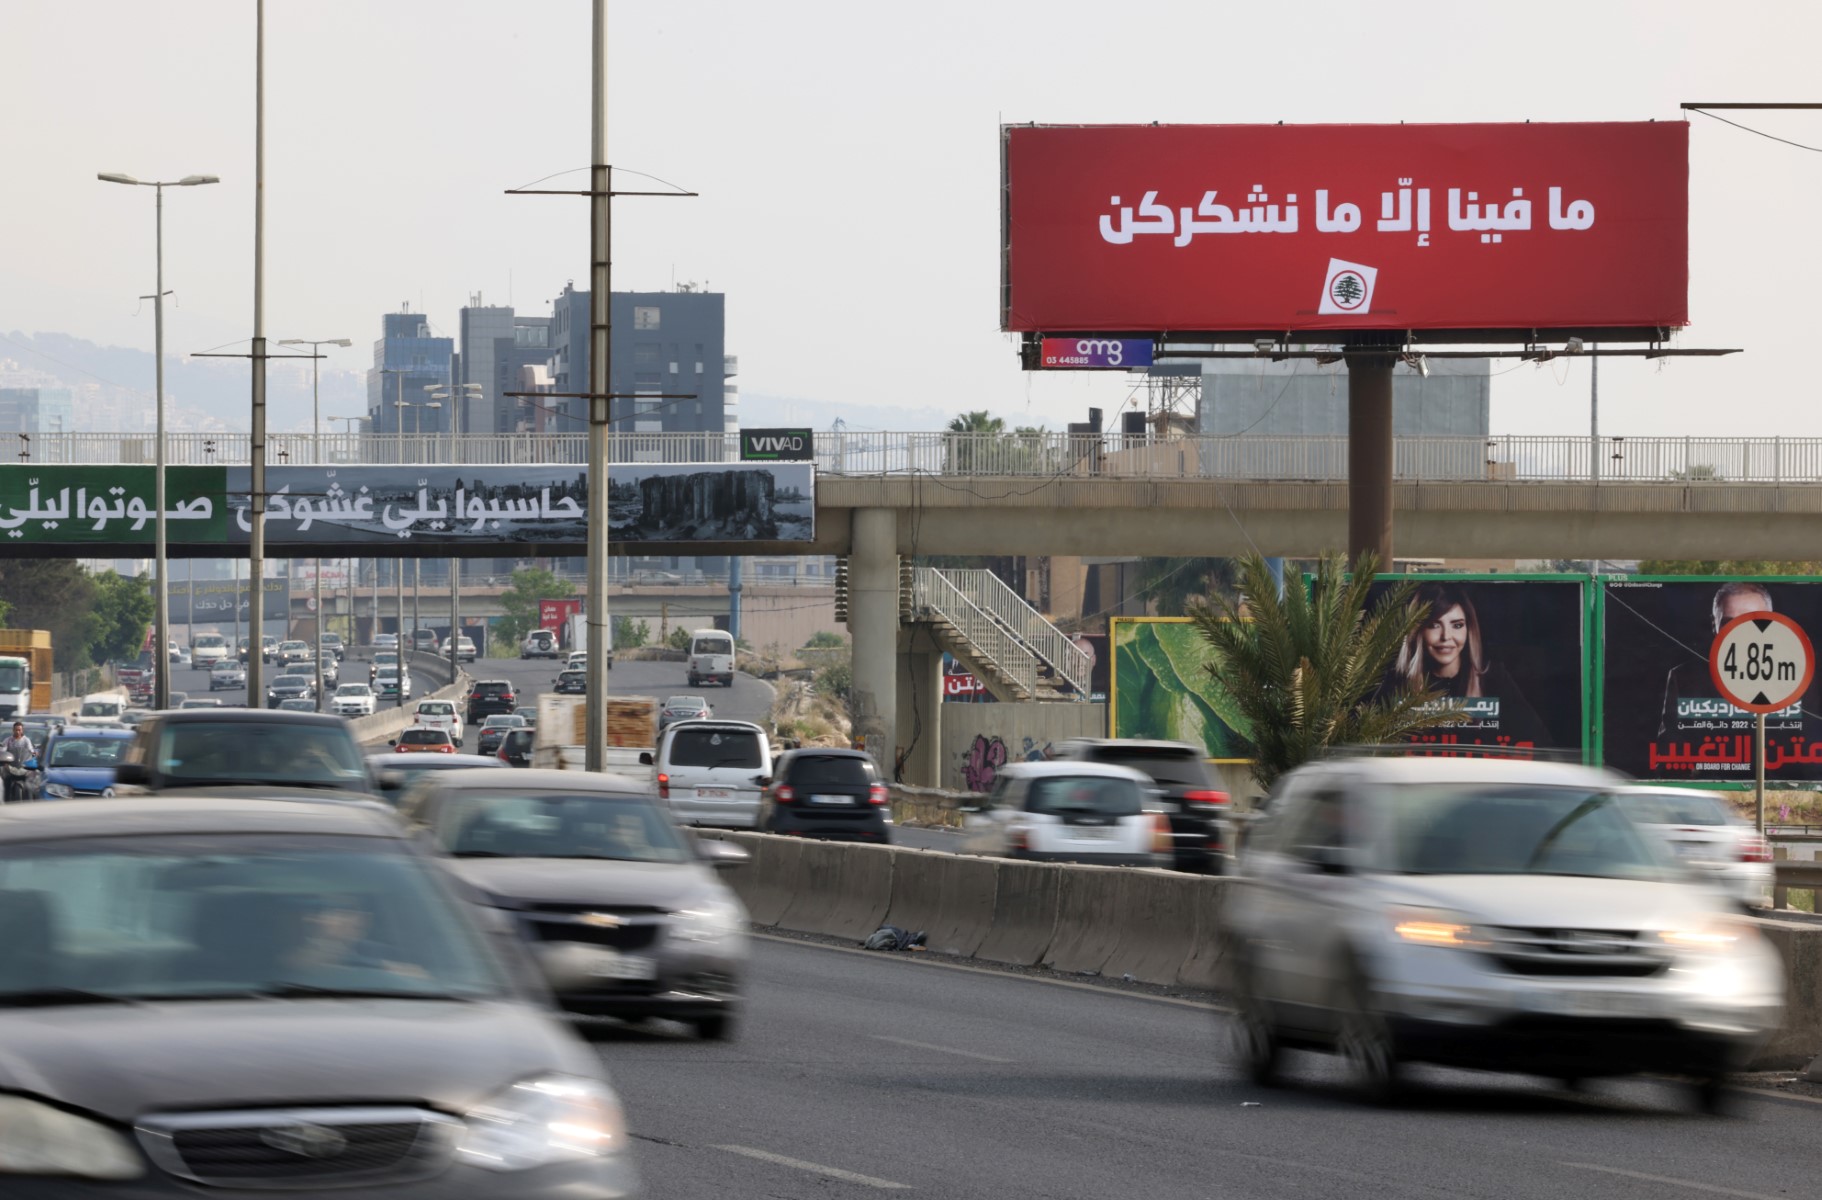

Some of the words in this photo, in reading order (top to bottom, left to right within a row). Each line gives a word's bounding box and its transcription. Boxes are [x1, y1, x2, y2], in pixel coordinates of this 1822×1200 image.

[1098, 184, 1299, 247] نشكركن
[1315, 189, 1362, 233] ما
[1447, 186, 1532, 243] فينا
[1548, 186, 1595, 231] ما
[751, 436, 803, 452] VIVAD
[455, 487, 585, 531] حاسبوا
[1724, 642, 1774, 681] 4.85
[1777, 660, 1796, 681] m
[1731, 721, 1749, 729] 2022
[1649, 735, 1751, 770] التغيير
